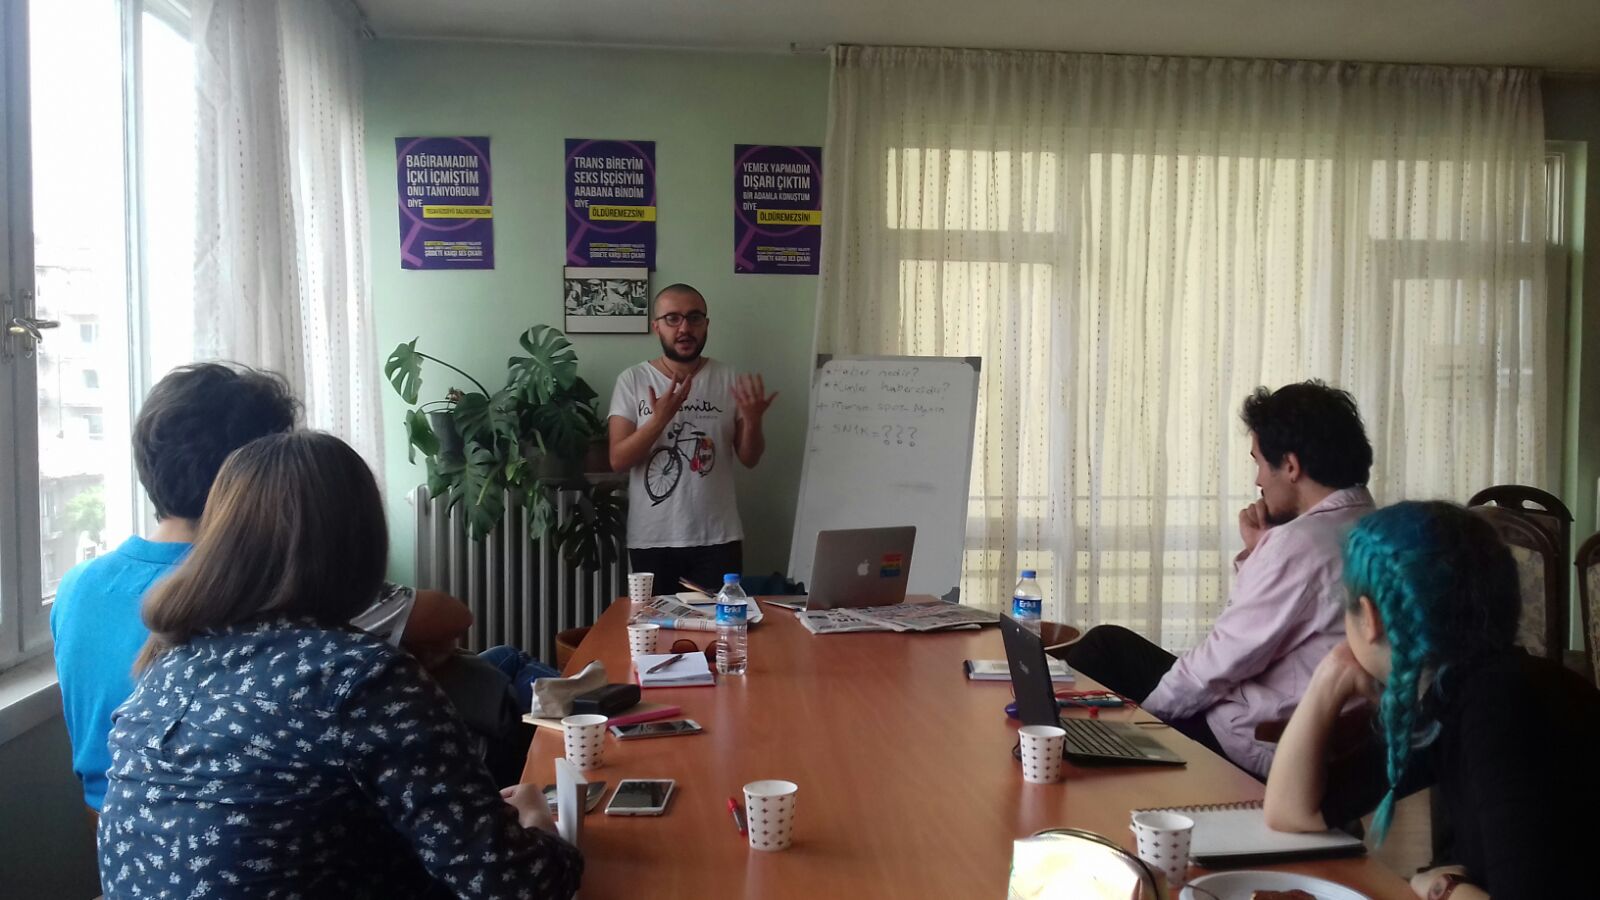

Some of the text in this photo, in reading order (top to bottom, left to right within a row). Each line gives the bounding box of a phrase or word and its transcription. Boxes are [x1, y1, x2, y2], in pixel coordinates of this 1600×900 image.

[406, 153, 478, 168] BAĞIRAMADIM
[574, 156, 643, 170] TRANS BİREYİM
[743, 162, 810, 174] YEMEK YAPMADIM
[407, 168, 479, 185] İÇKİ İÇMİŞTİM
[574, 170, 644, 186] SEKS İŞÇİSİYİM
[743, 175, 810, 190] DIŞARI ÇIKTIM
[407, 186, 479, 197] ONU TANIYORDUM
[574, 185, 644, 198] ARABANA BİNDİM
[743, 191, 753, 200] BİR
[779, 192, 810, 201] KONUŞTUM
[407, 198, 423, 208] DİYE
[574, 199, 589, 208] DİYE
[743, 201, 757, 210] DİYE
[592, 207, 645, 217] ÖLDÜREMEZSİN!
